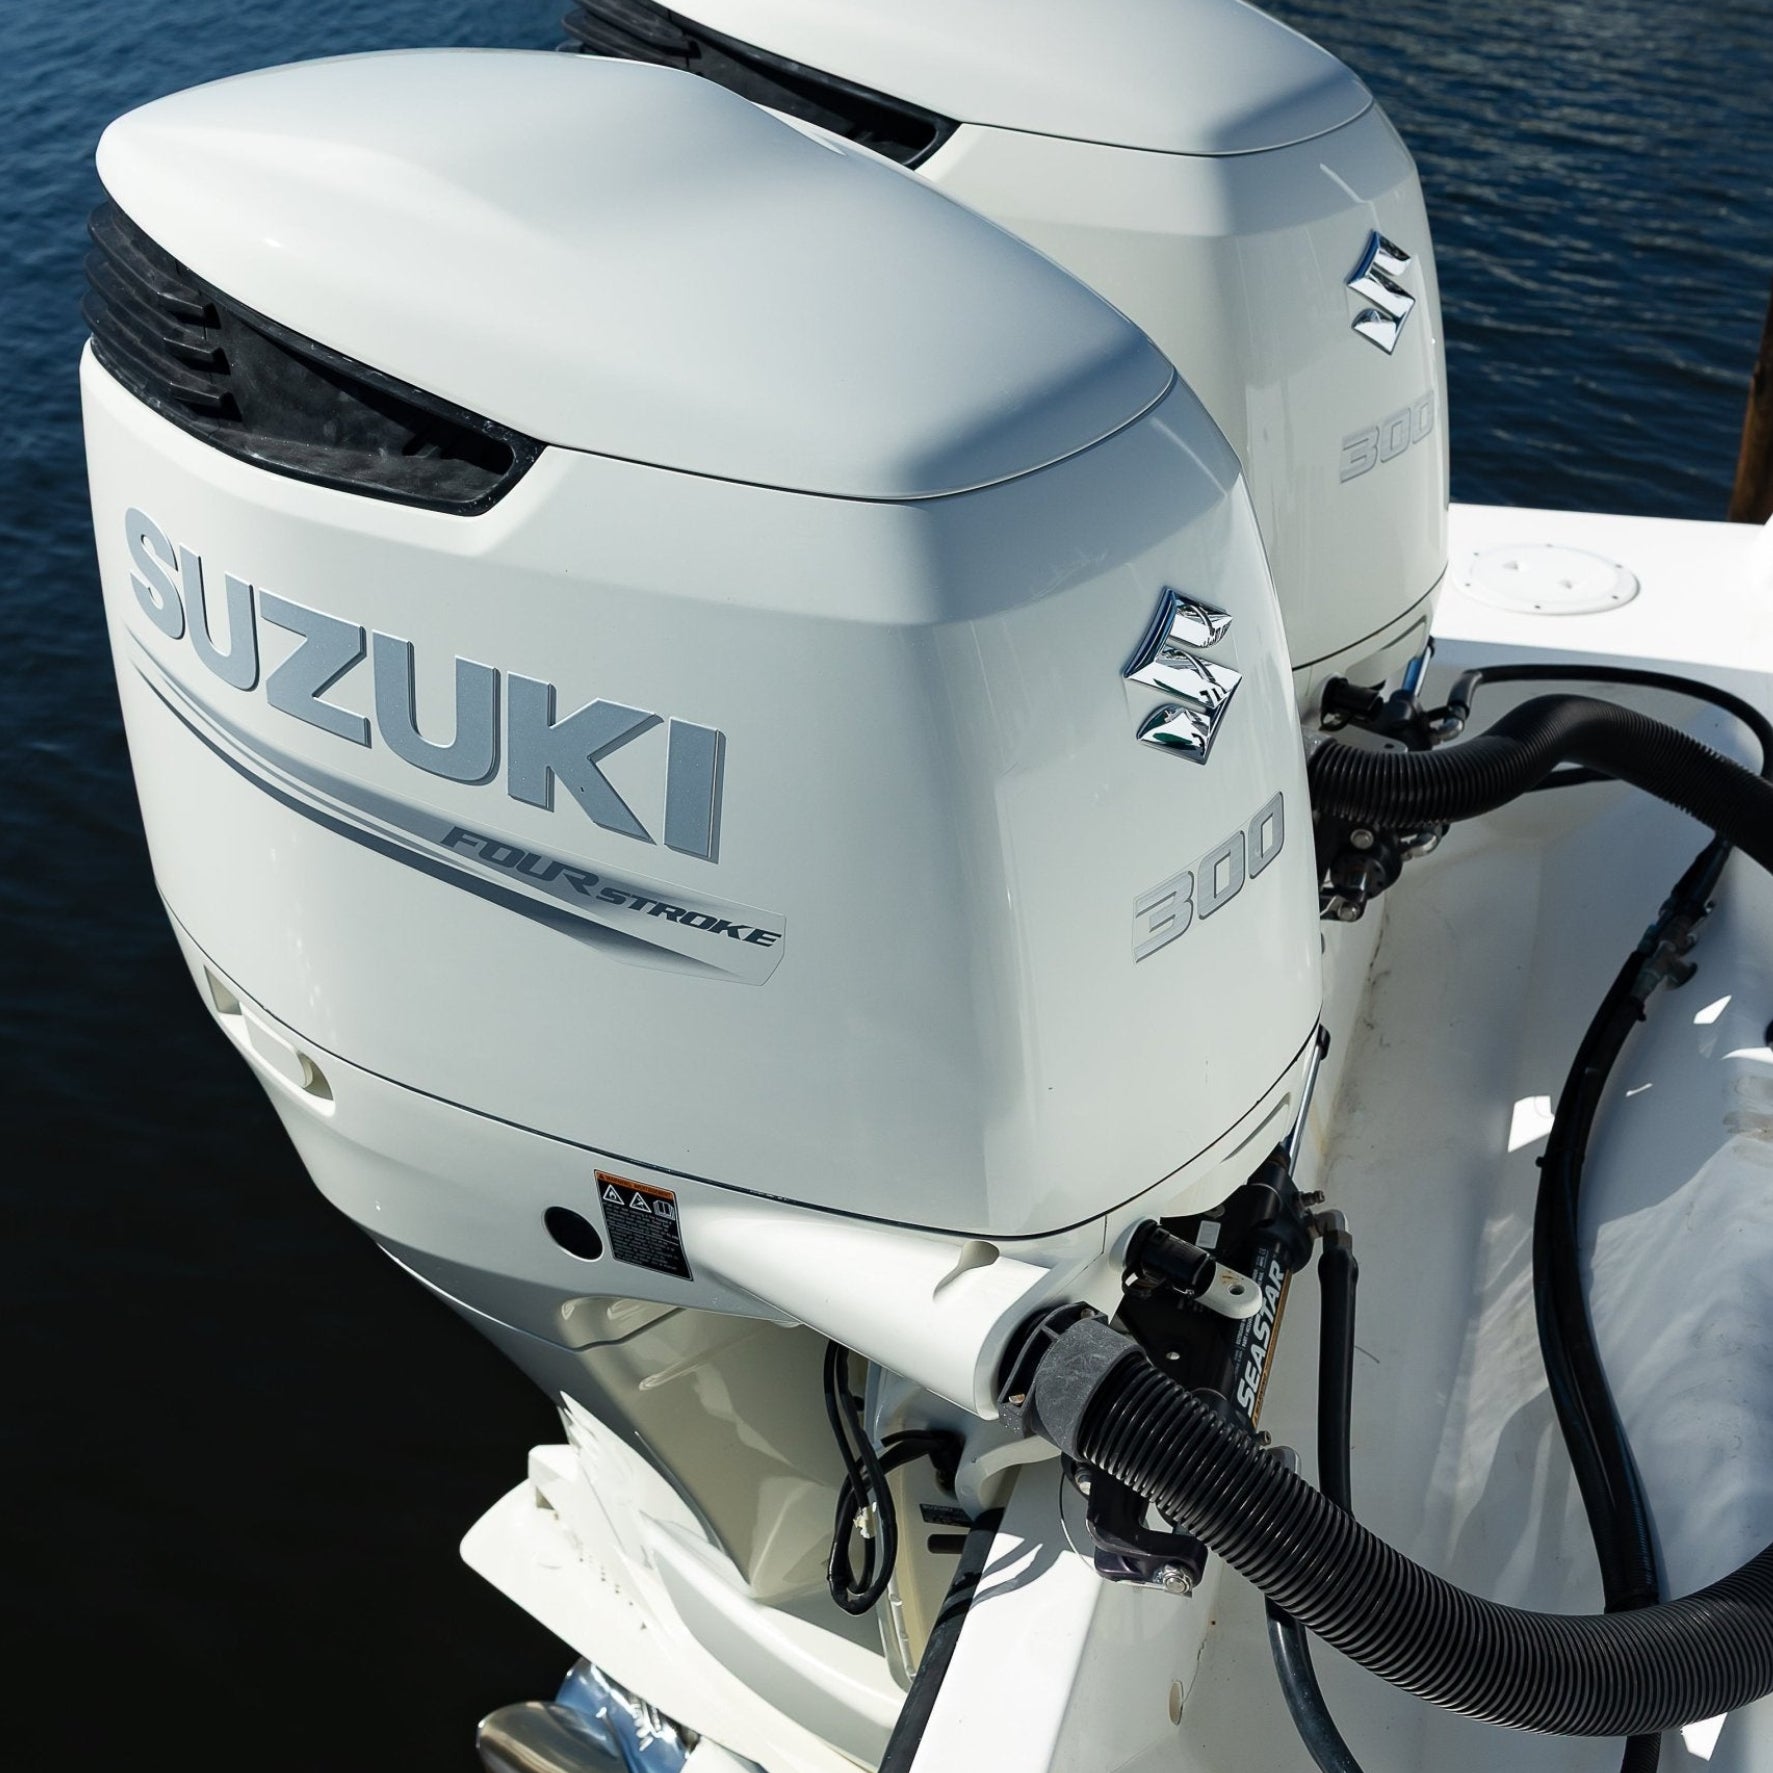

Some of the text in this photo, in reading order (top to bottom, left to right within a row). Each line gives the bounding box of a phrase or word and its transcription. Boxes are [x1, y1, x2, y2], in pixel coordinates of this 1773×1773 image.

[1340, 390, 1435, 484] 300
[125, 507, 726, 865] SUZUKI
[439, 826, 782, 948] FOUR STROKE
[1134, 791, 1285, 962] 300
[1237, 1260, 1284, 1419] SEASTAR
